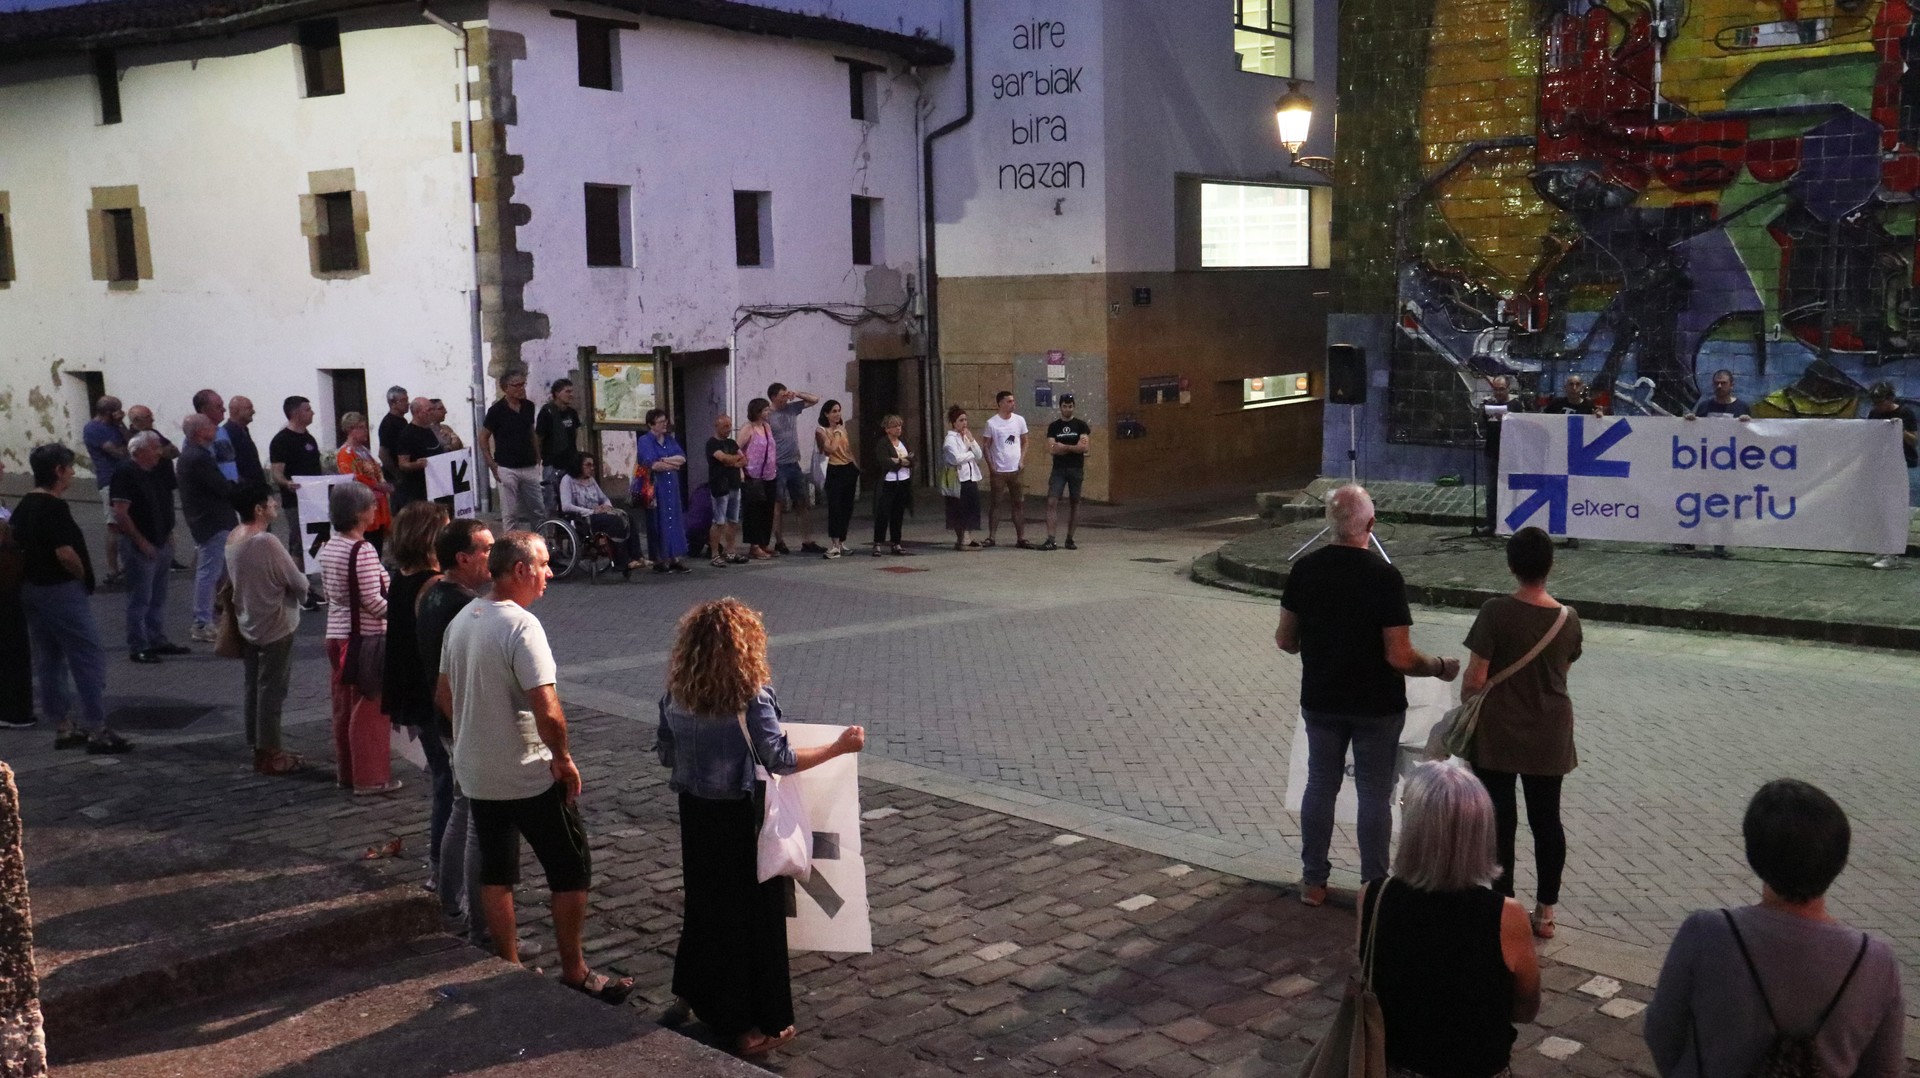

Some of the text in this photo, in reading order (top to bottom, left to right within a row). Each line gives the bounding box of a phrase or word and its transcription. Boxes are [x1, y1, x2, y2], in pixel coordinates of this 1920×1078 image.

[1013, 17, 1066, 51] aire
[991, 64, 1083, 100] garbiak
[1012, 114, 1068, 145] bira
[999, 160, 1086, 190] nazan
[1672, 435, 1797, 470] bidea
[1571, 499, 1639, 519] etxera
[1675, 484, 1797, 529] gertu
